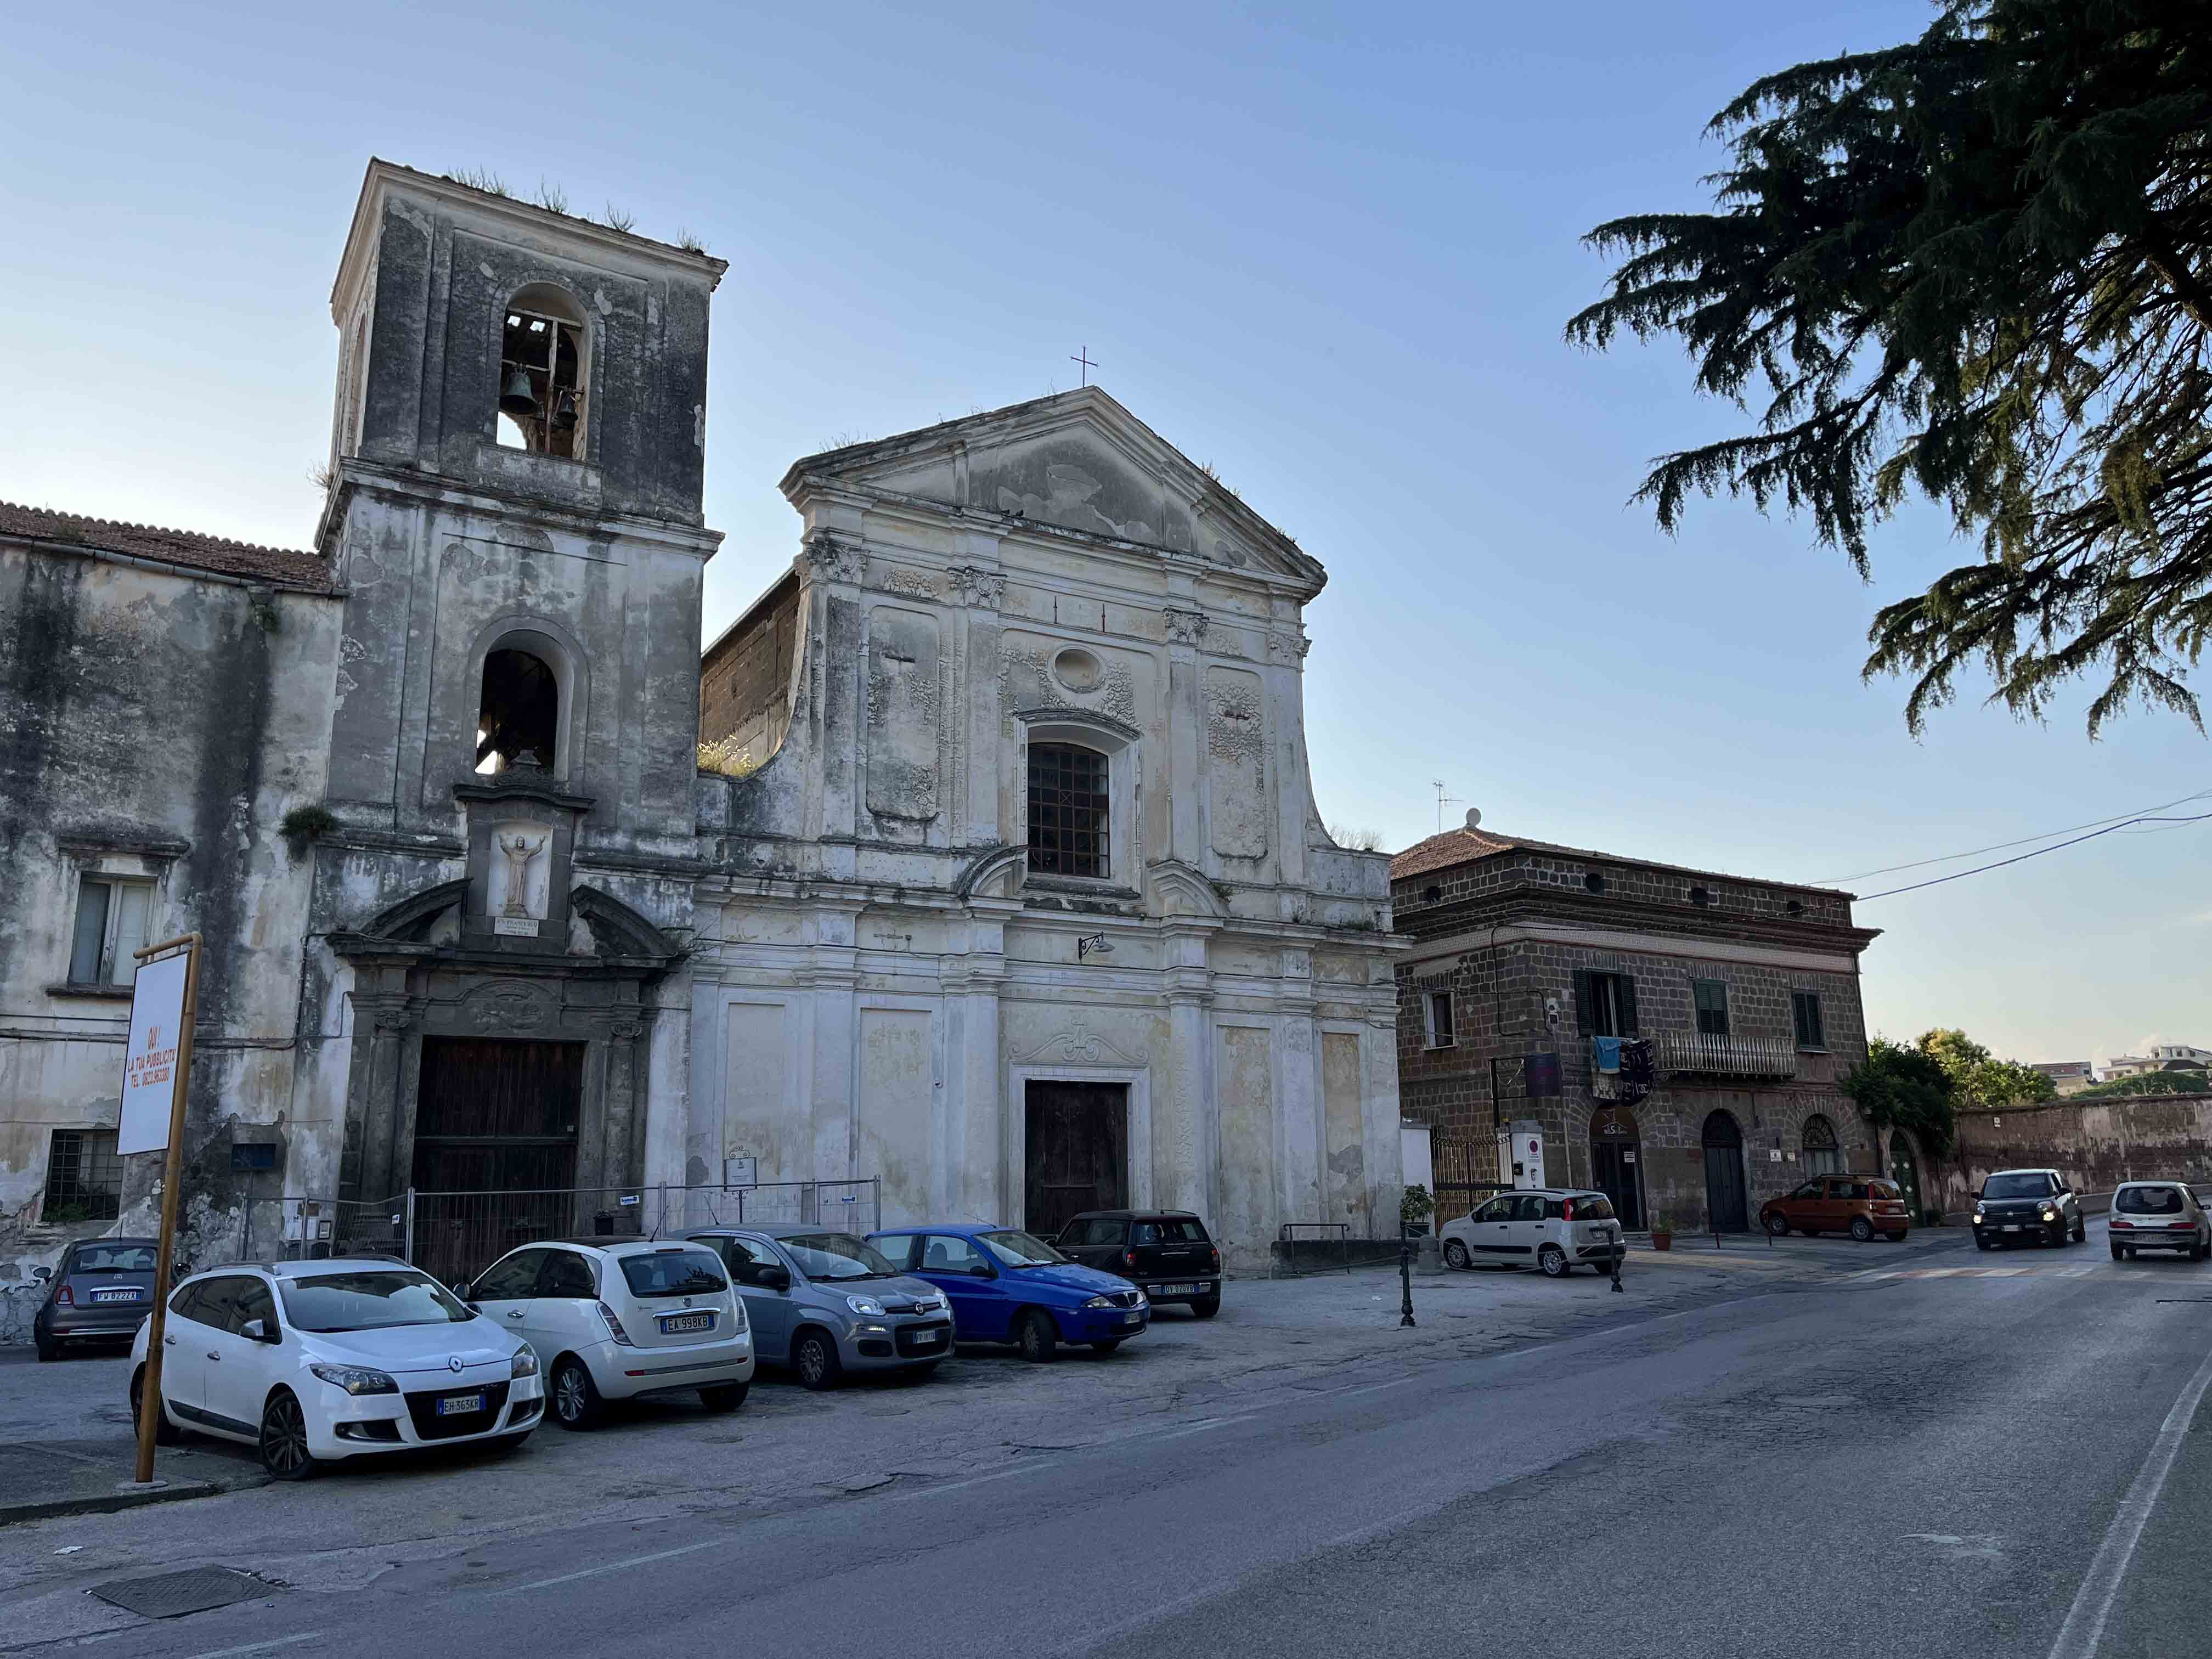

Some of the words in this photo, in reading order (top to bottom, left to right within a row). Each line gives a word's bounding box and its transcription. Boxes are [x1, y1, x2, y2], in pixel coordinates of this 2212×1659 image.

[148, 1026, 158, 1049] QUI
[128, 1058, 134, 1072] LA
[136, 1054, 145, 1071] TUA
[668, 1319, 680, 1330] EA
[681, 1317, 708, 1329] 998KB
[444, 1401, 454, 1412] EH
[456, 1398, 479, 1410] 363KR
